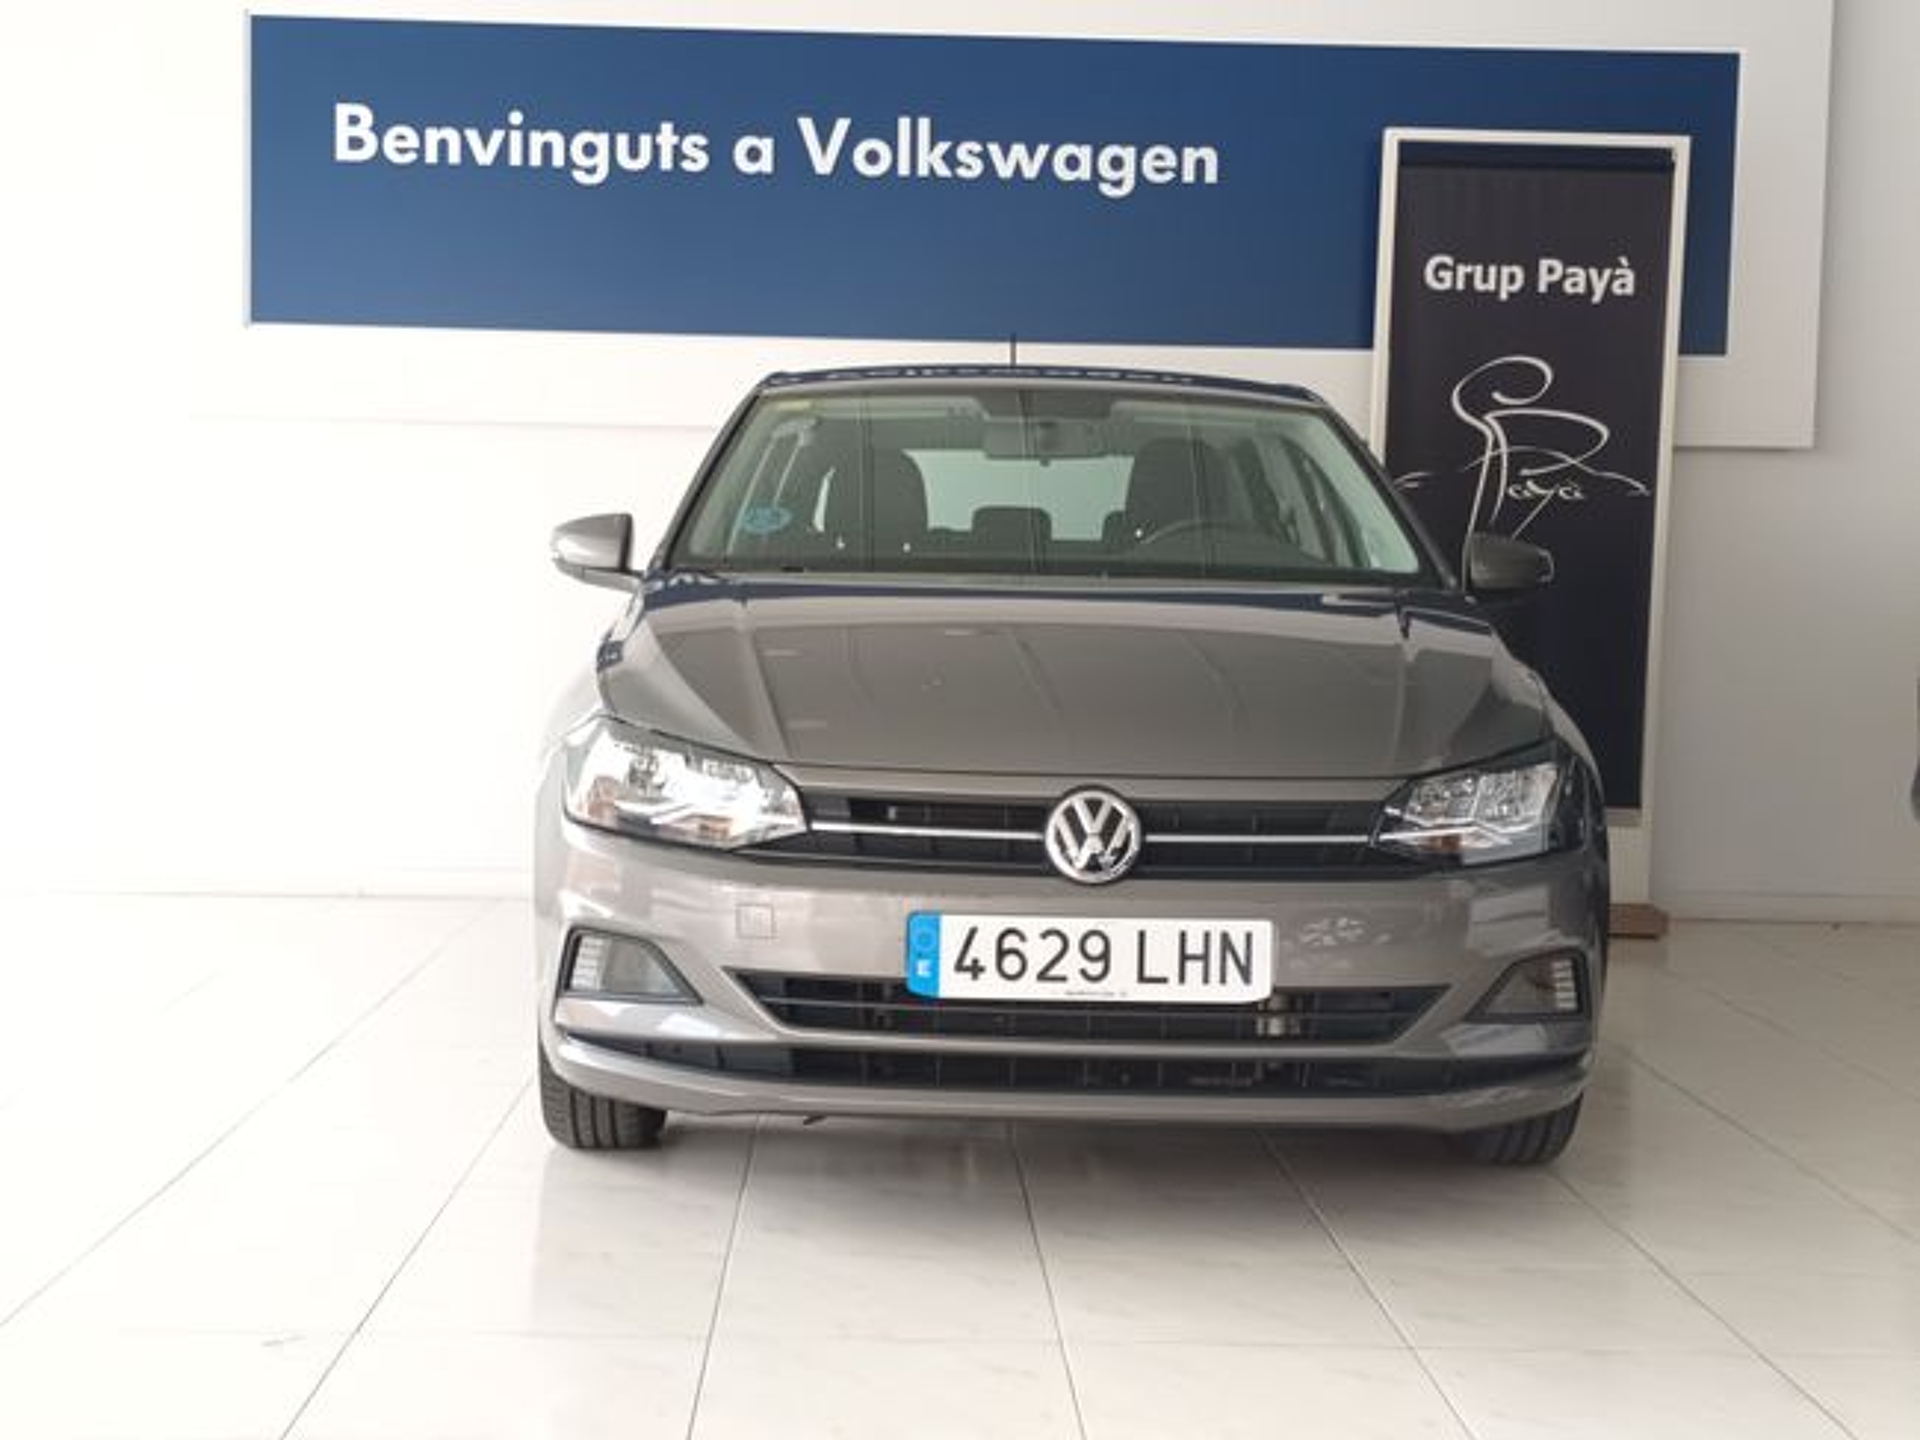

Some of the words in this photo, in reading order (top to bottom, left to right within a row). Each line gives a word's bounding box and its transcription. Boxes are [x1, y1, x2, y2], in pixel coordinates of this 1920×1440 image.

[334, 102, 710, 185] Benvinguts
[733, 135, 774, 175] a
[797, 116, 1218, 198] Volkswagen
[1424, 254, 1525, 301] Grup
[1537, 256, 1635, 304] Payà
[954, 926, 1111, 983] 4629
[1136, 929, 1253, 985] LHN
